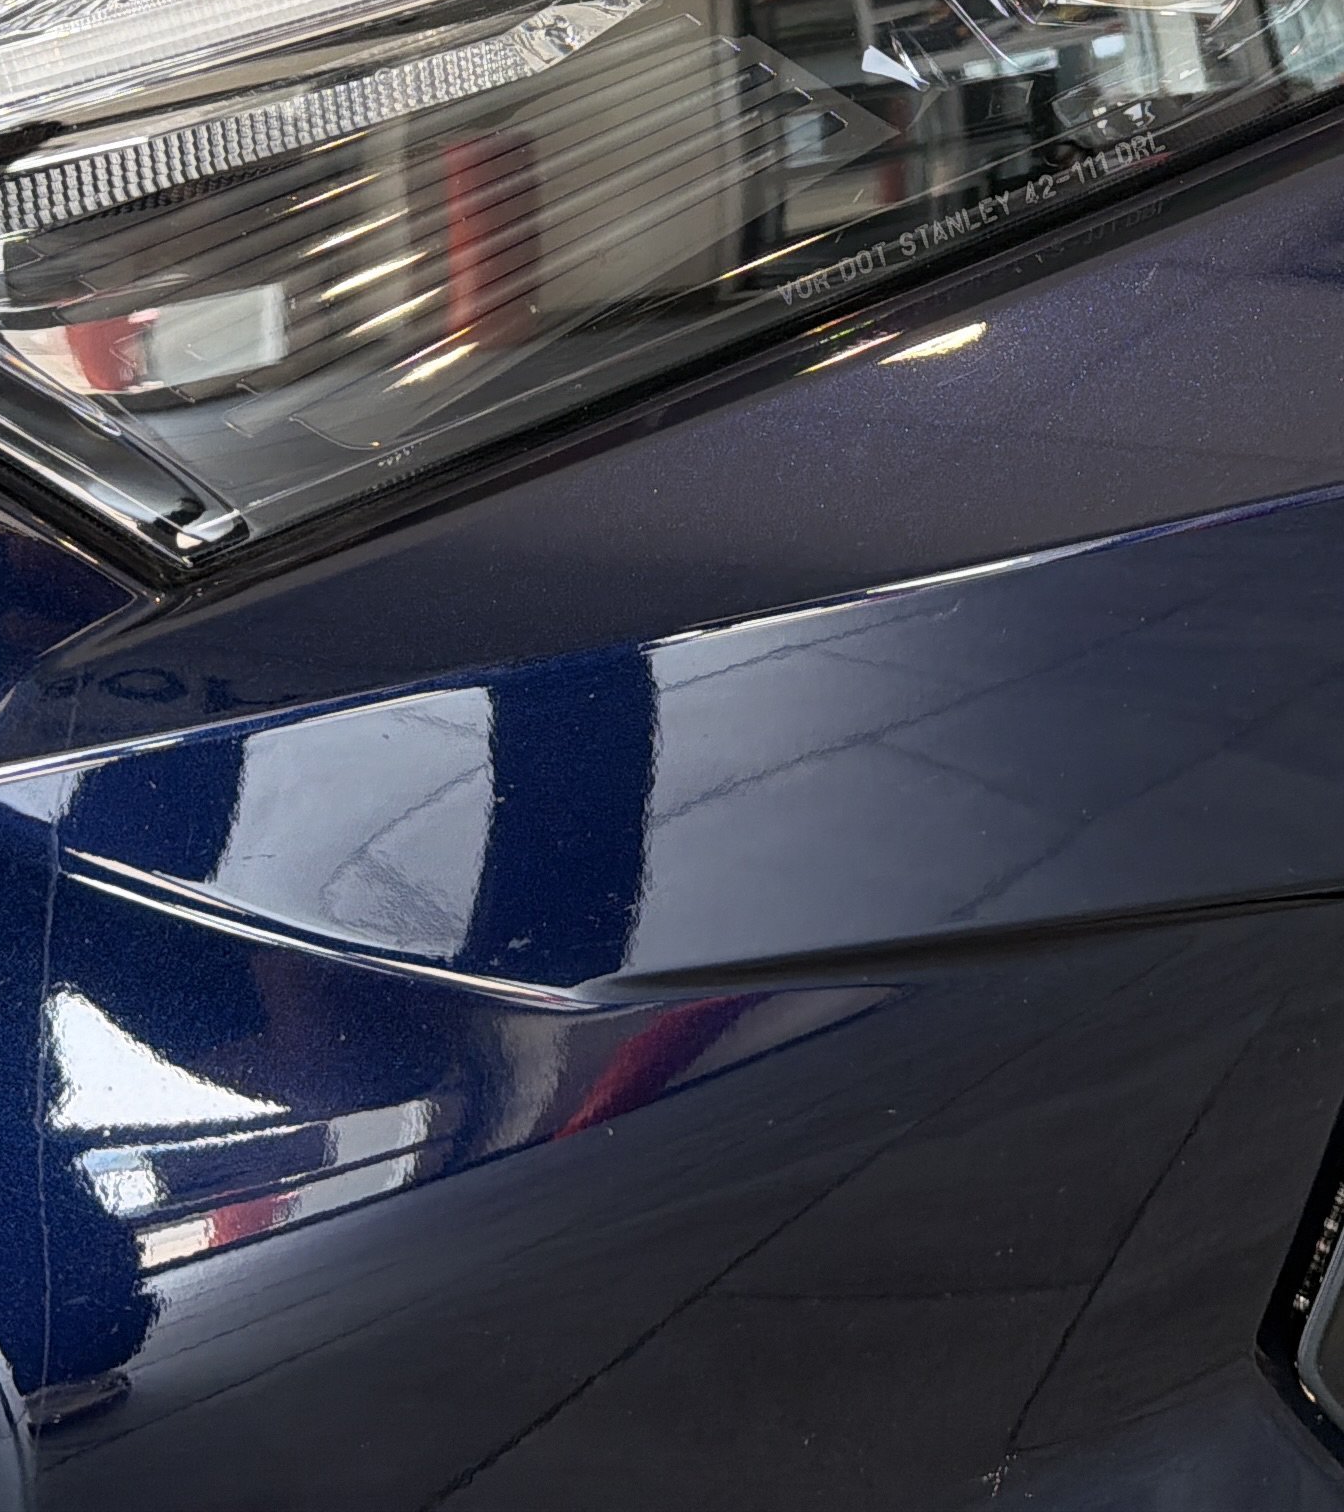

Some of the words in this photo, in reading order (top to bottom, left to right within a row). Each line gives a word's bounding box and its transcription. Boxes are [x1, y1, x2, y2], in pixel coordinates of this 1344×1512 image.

[775, 271, 831, 306] VOR
[840, 240, 891, 286] DOT
[898, 188, 1012, 257] STANLEY
[1022, 149, 1112, 206] 42-111
[1113, 129, 1167, 172] DRL
